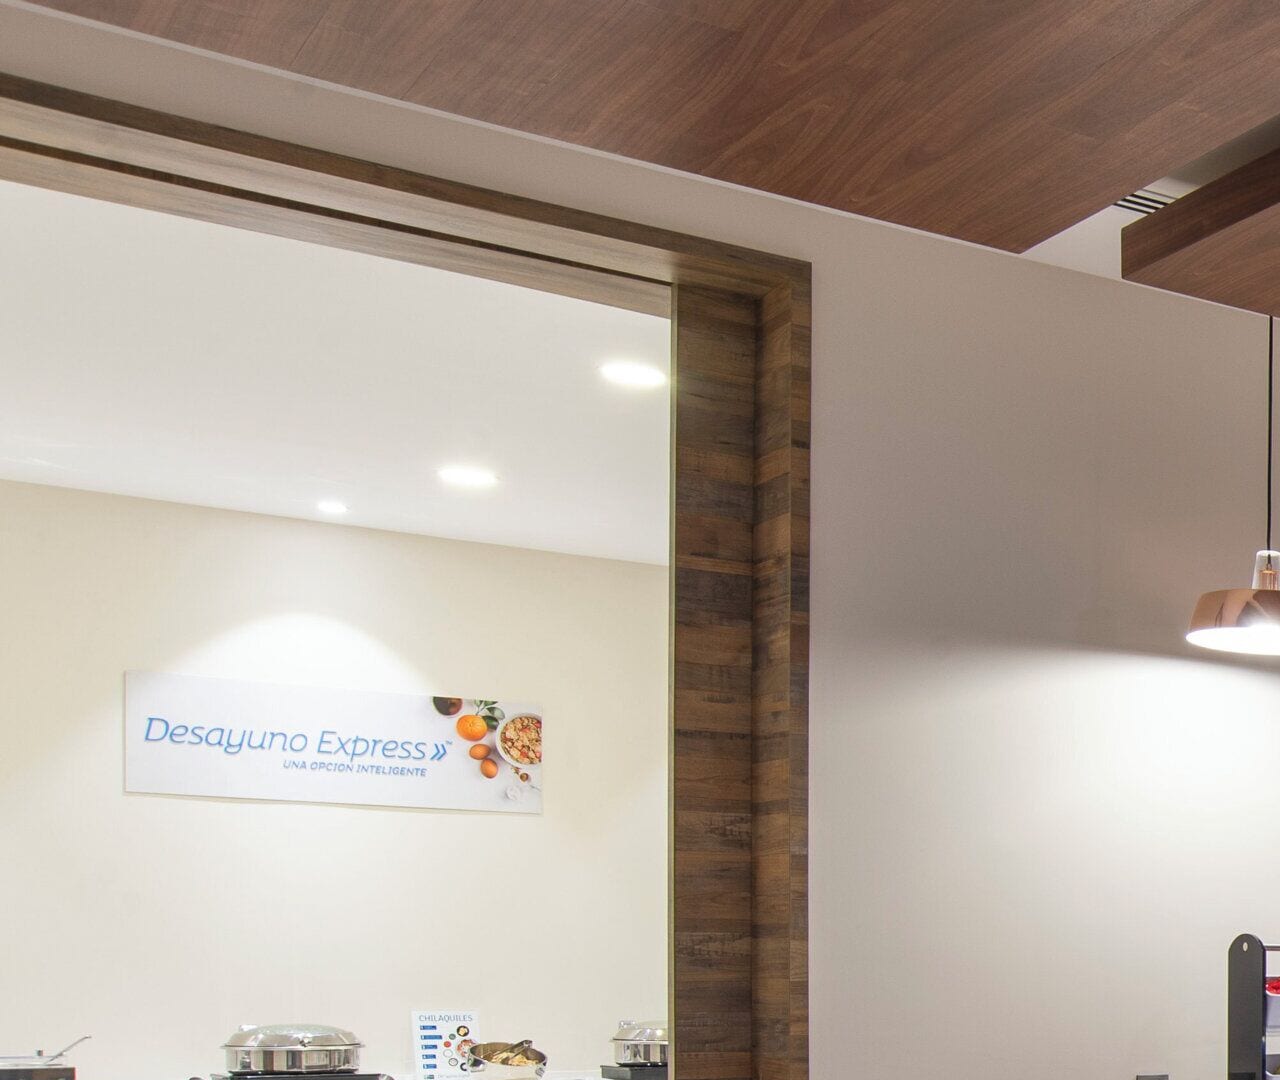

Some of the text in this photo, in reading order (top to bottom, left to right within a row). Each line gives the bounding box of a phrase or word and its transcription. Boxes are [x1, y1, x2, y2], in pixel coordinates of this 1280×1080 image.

[144, 717, 427, 762] Desayuno Express
[283, 760, 307, 770] UNA
[357, 763, 428, 777] INTELIGENTE
[418, 1014, 473, 1023] CHILAQUILES
